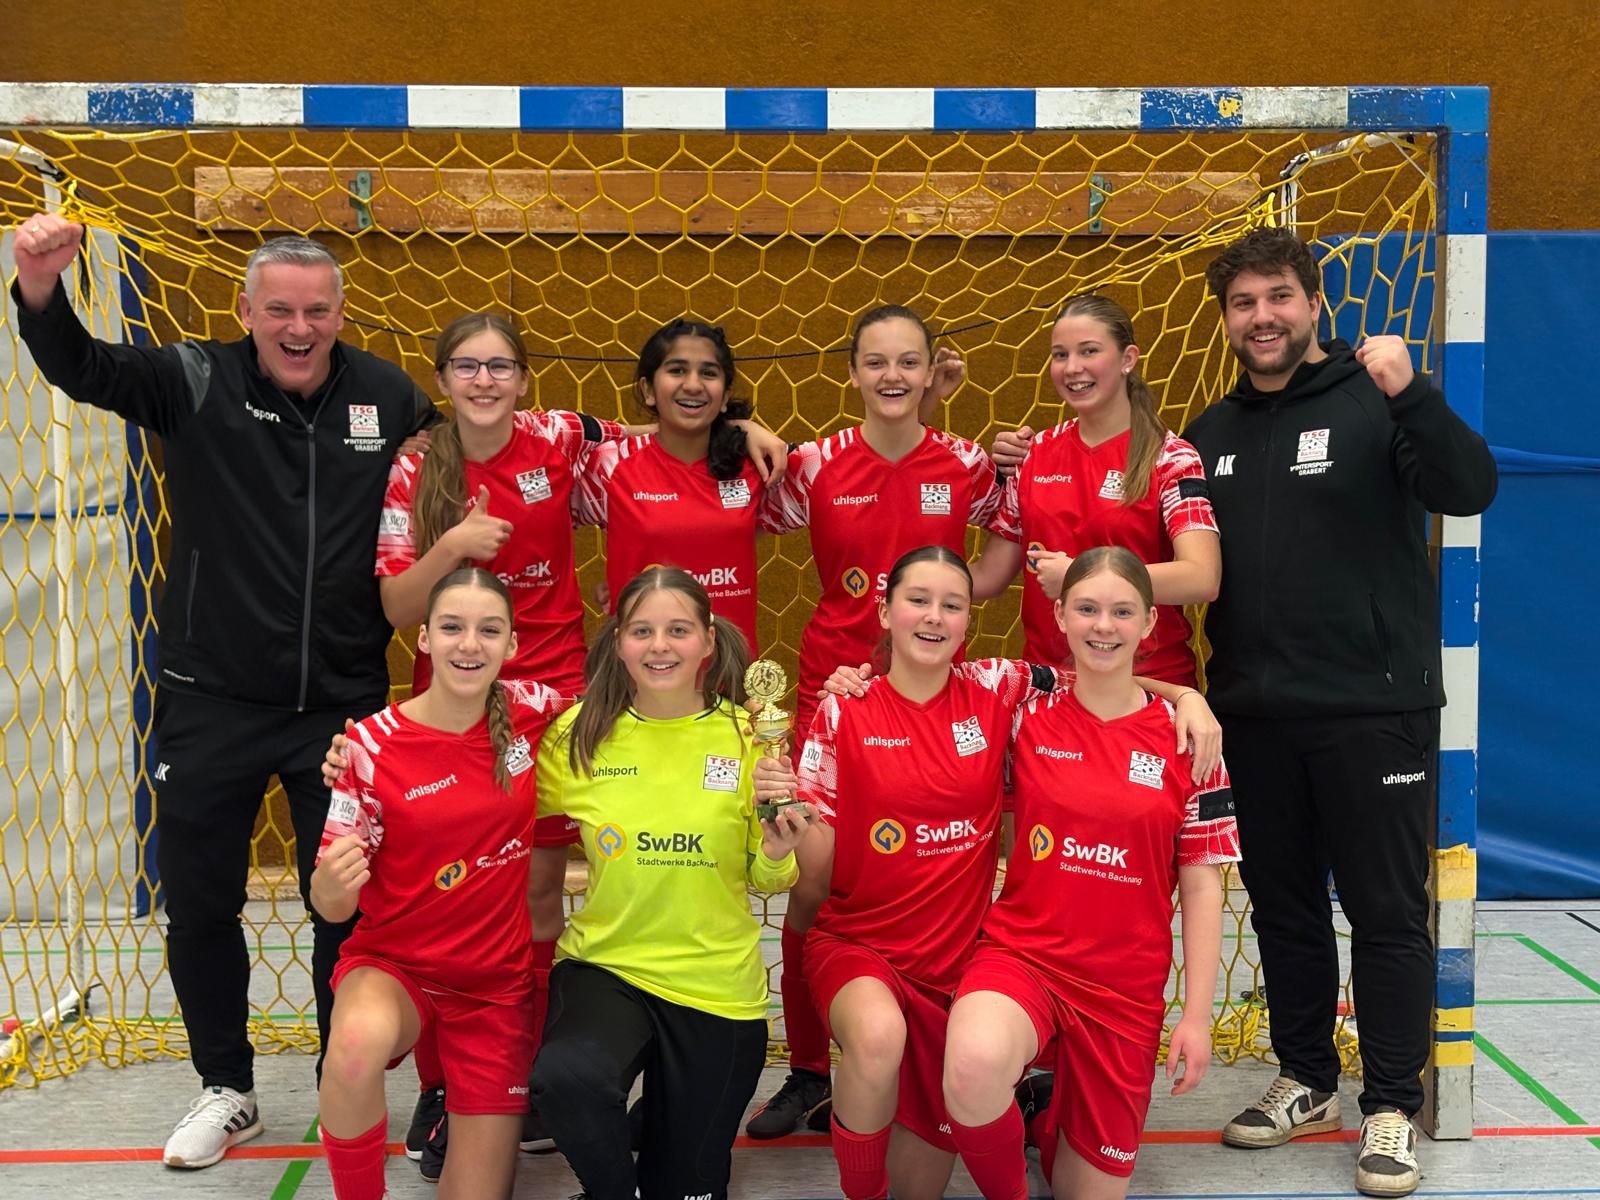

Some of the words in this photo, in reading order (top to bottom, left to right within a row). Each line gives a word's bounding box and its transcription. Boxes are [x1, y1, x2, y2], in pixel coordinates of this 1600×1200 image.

[351, 406, 374, 414] TSG
[1303, 430, 1326, 440] TSG
[354, 444, 382, 452] GRABERT
[1214, 454, 1237, 477] AK
[1298, 467, 1327, 476] GRABERT
[519, 468, 544, 481] TSG
[721, 480, 745, 488] TSG
[923, 484, 948, 492] TSG
[633, 492, 679, 503] uhlsport
[833, 492, 879, 506] uhlsport
[955, 716, 978, 731] TSG
[864, 735, 911, 748] uhlsport
[1035, 745, 1083, 761] uhlsport
[1135, 752, 1163, 767] TSG
[710, 757, 737, 767] TSG
[154, 762, 171, 782] JK
[592, 766, 638, 778] uhlsport
[1132, 771, 1161, 784] Backnang
[1382, 770, 1426, 785] uhlsport
[404, 773, 458, 801] uhlsport
[707, 777, 735, 787] Backnang
[915, 818, 979, 844] SwBK
[636, 831, 704, 854] SwBK
[916, 844, 964, 857] Stadtwerke
[1061, 837, 1129, 869] SwBK
[636, 857, 685, 867] Stadtwerke
[1059, 861, 1107, 879] Stadtwerke
[1108, 871, 1143, 886] Backnang
